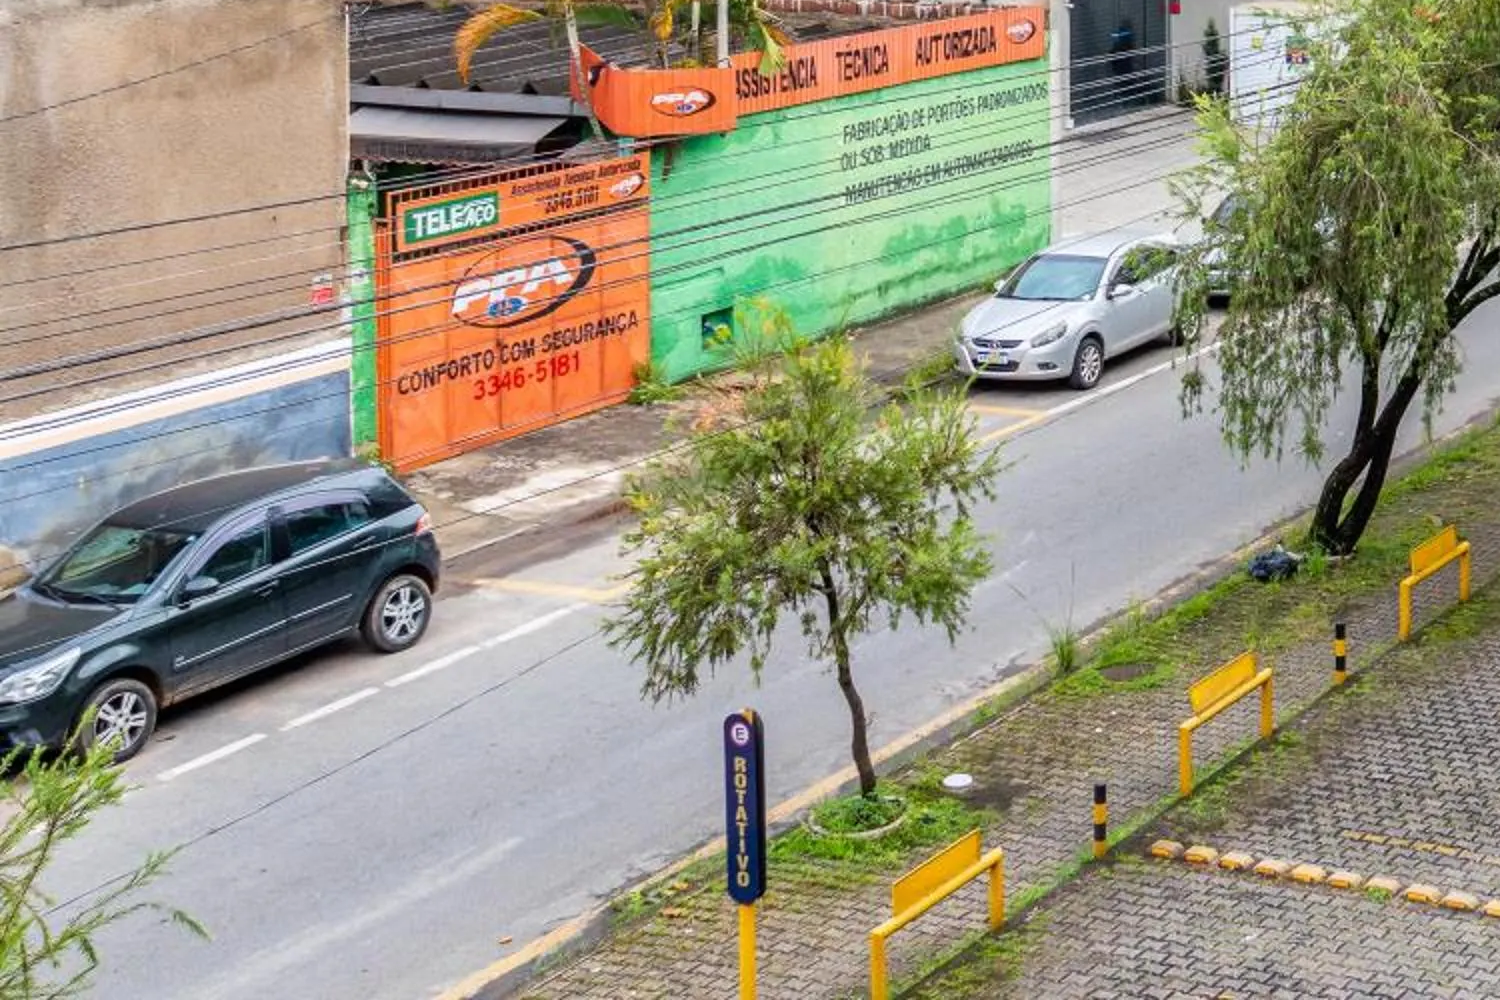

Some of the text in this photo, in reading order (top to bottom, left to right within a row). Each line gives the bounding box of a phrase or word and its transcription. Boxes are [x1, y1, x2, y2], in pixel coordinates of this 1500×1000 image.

[836, 44, 889, 82] TÉCNICA
[915, 26, 998, 66] AUTORIZADA
[843, 110, 909, 144] FABRICAÇÃO
[912, 107, 925, 128] DE
[928, 96, 975, 125] PORTÕES
[841, 153, 857, 171] OU
[889, 134, 931, 157] MEDIDA
[452, 259, 573, 314] PPA
[397, 310, 639, 396] CONFORTO COM SEGURANÇA
[473, 351, 580, 400] 3346-5181
[735, 727, 746, 741] E
[734, 756, 750, 888] ROTATIVO
